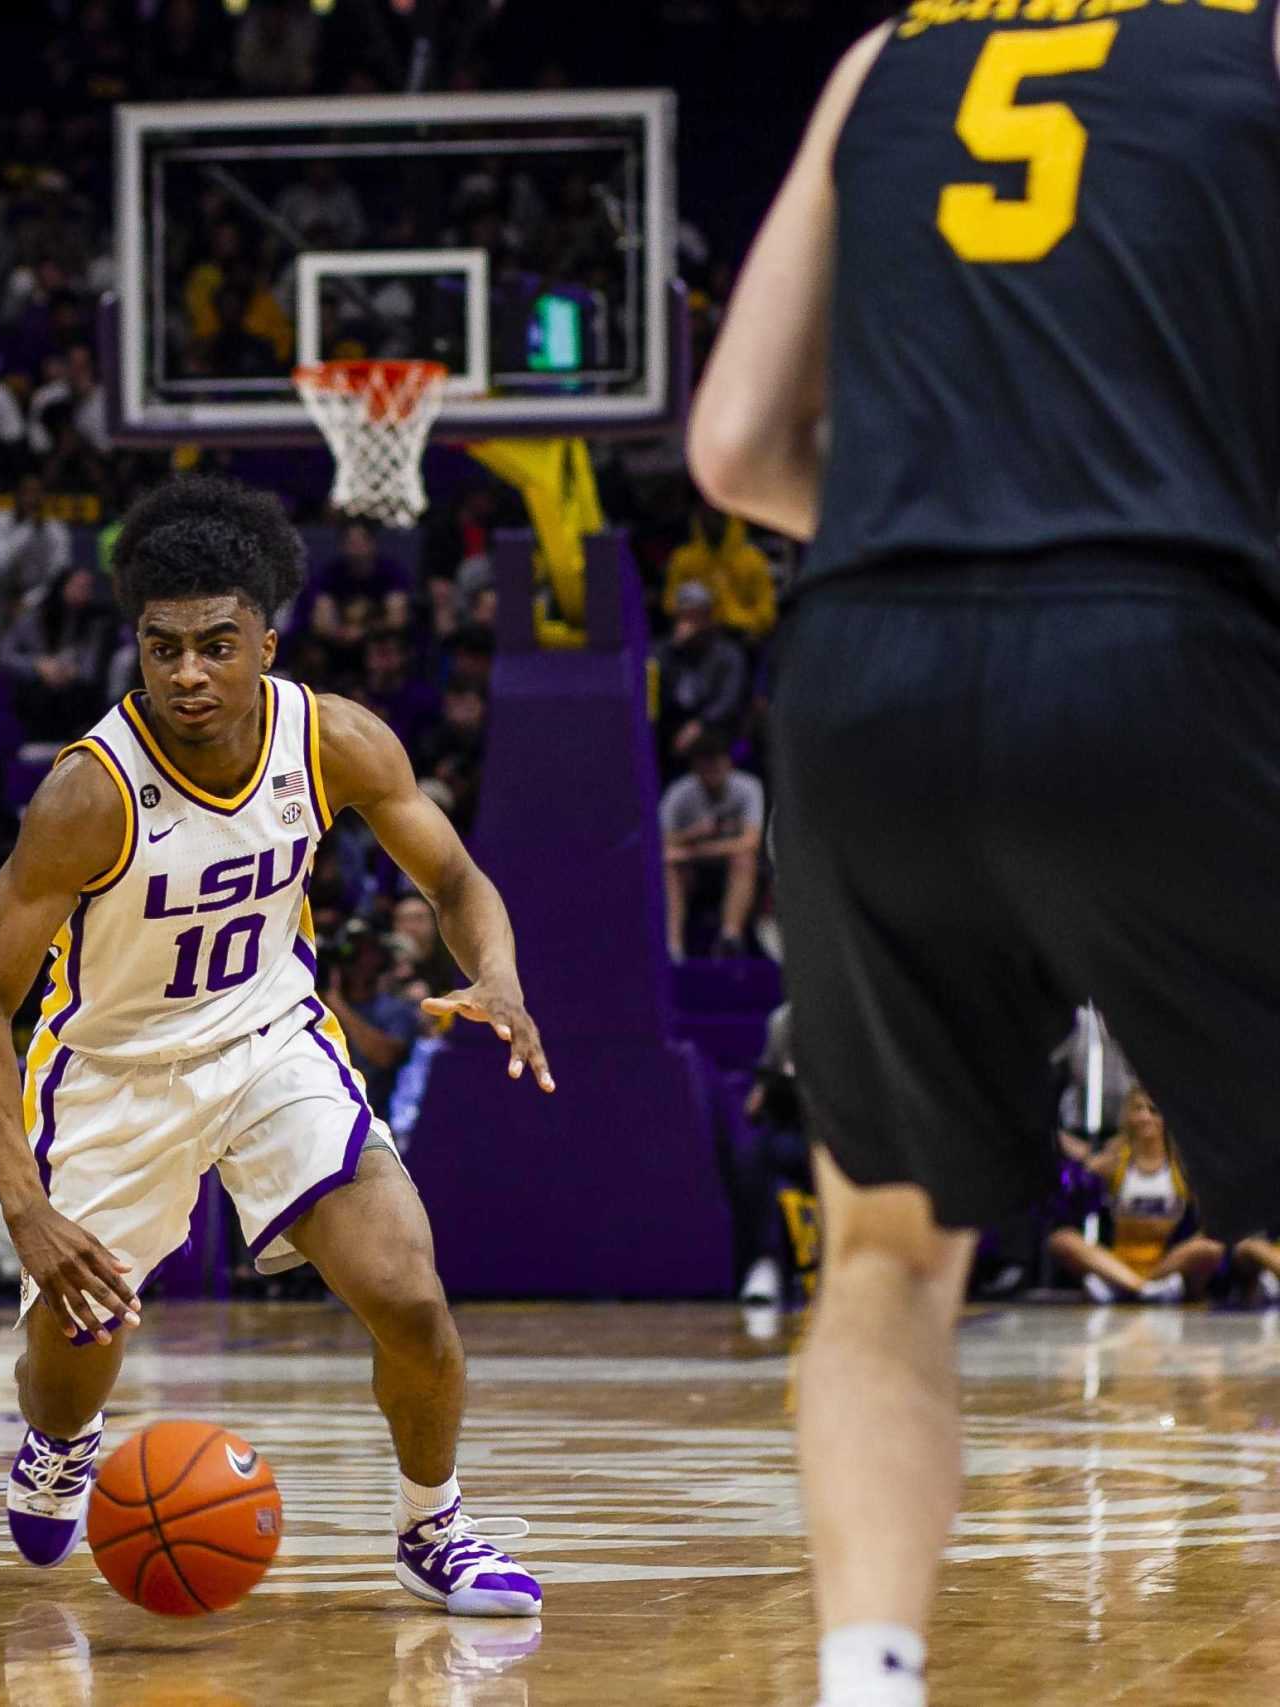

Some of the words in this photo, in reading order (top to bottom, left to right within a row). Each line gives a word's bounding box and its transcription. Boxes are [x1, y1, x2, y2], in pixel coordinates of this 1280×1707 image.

[936, 18, 1119, 264] 5
[143, 836, 309, 920] LSU
[163, 912, 267, 999] 10
